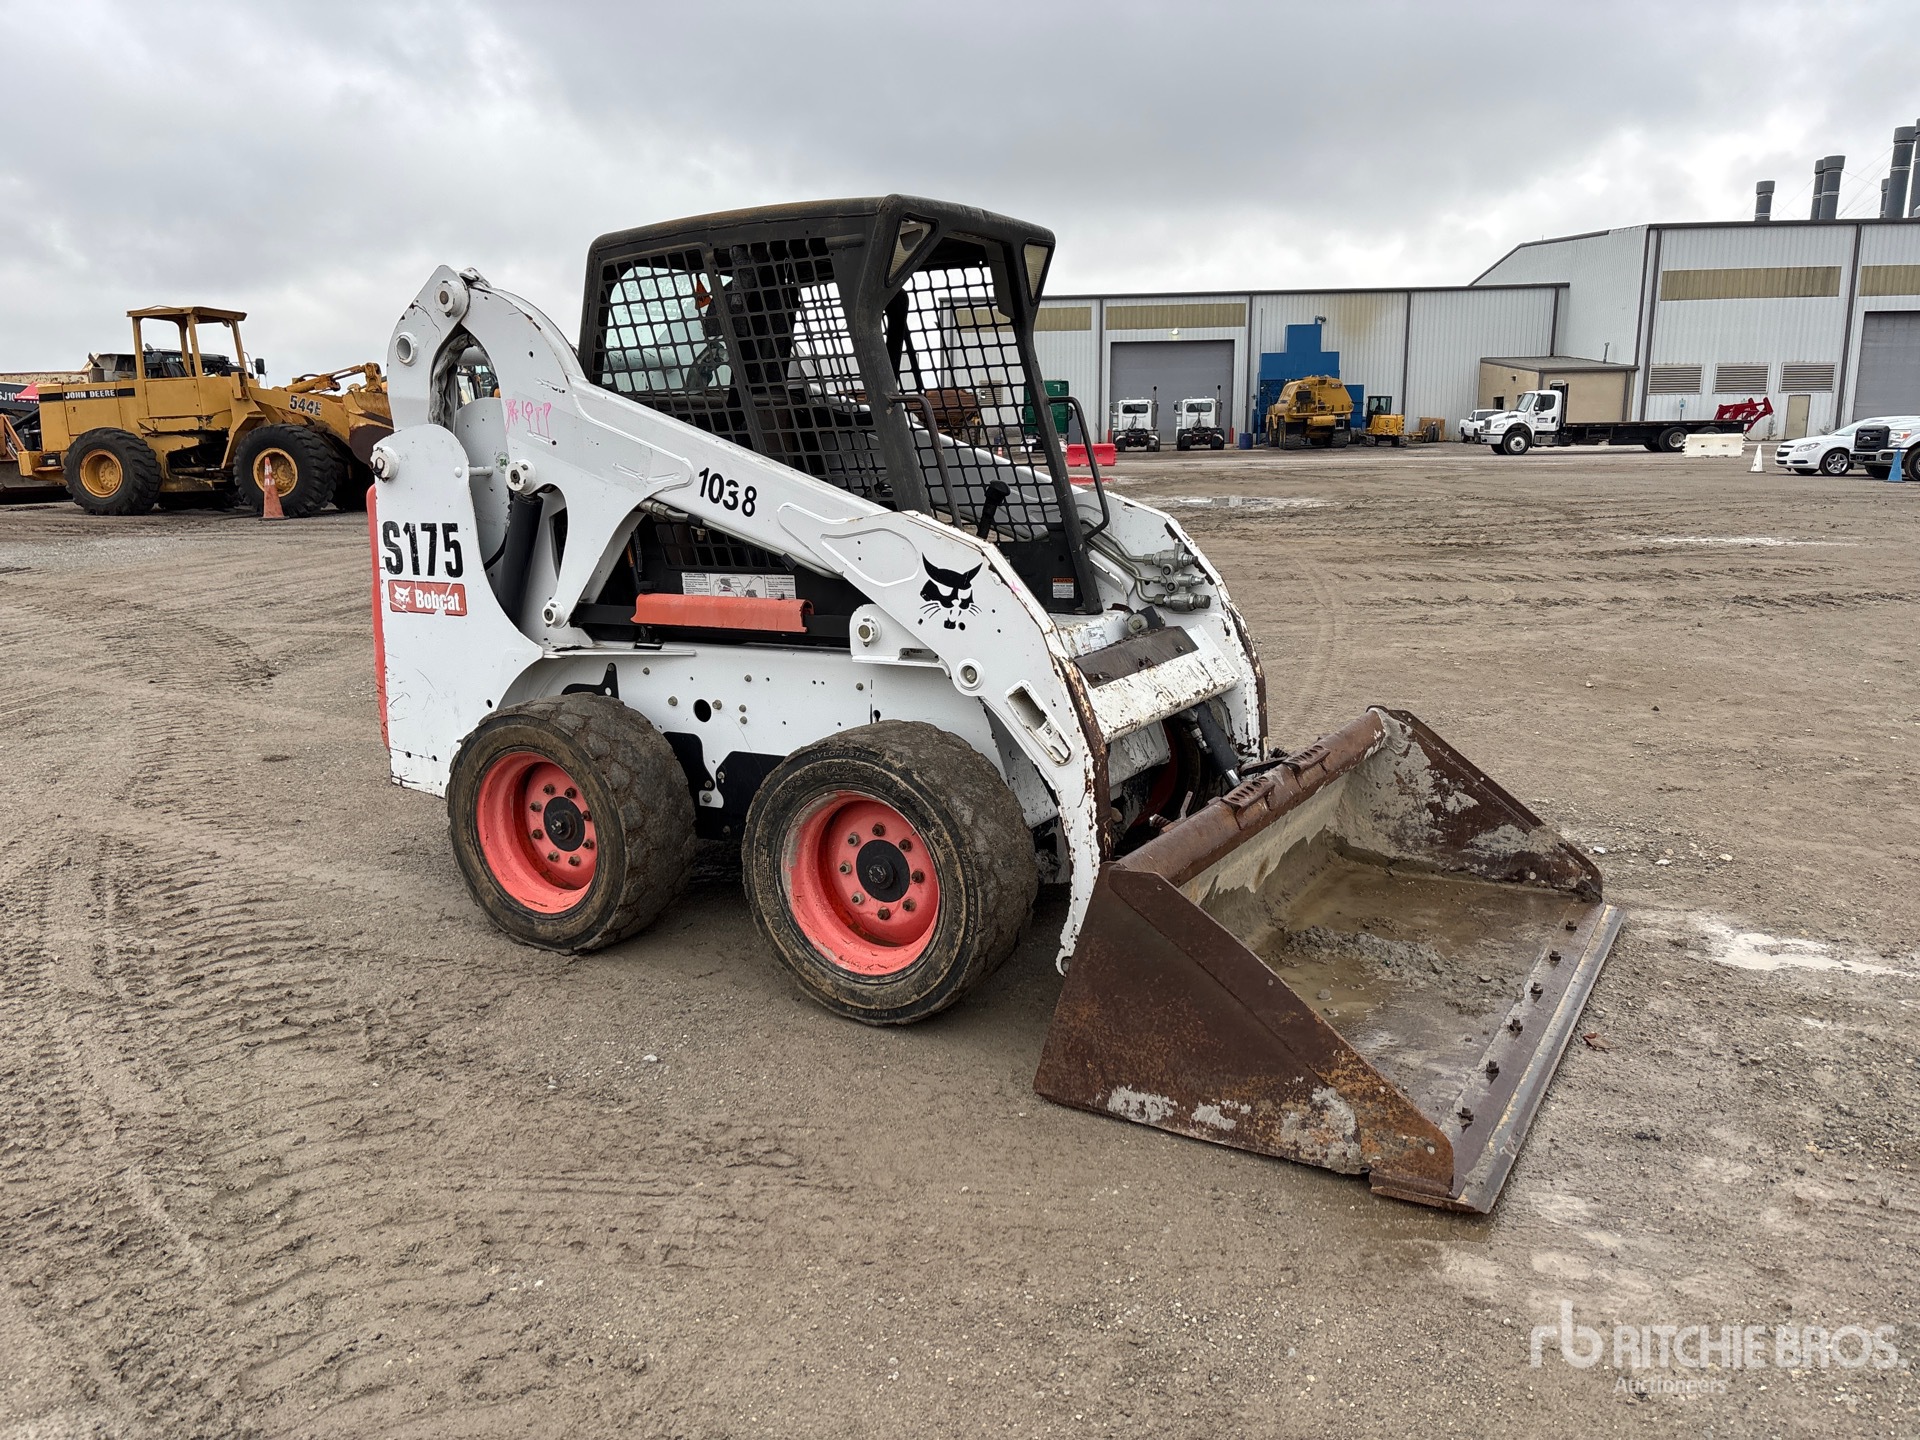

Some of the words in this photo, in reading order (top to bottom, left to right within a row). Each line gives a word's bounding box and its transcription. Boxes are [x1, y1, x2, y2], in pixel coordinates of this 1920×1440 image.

[65, 391, 87, 400] JOHN
[89, 389, 116, 399] DEERE
[289, 395, 322, 416] 544E
[698, 467, 757, 517] 1038
[382, 520, 464, 578] S175
[414, 588, 461, 612] Bobcat
